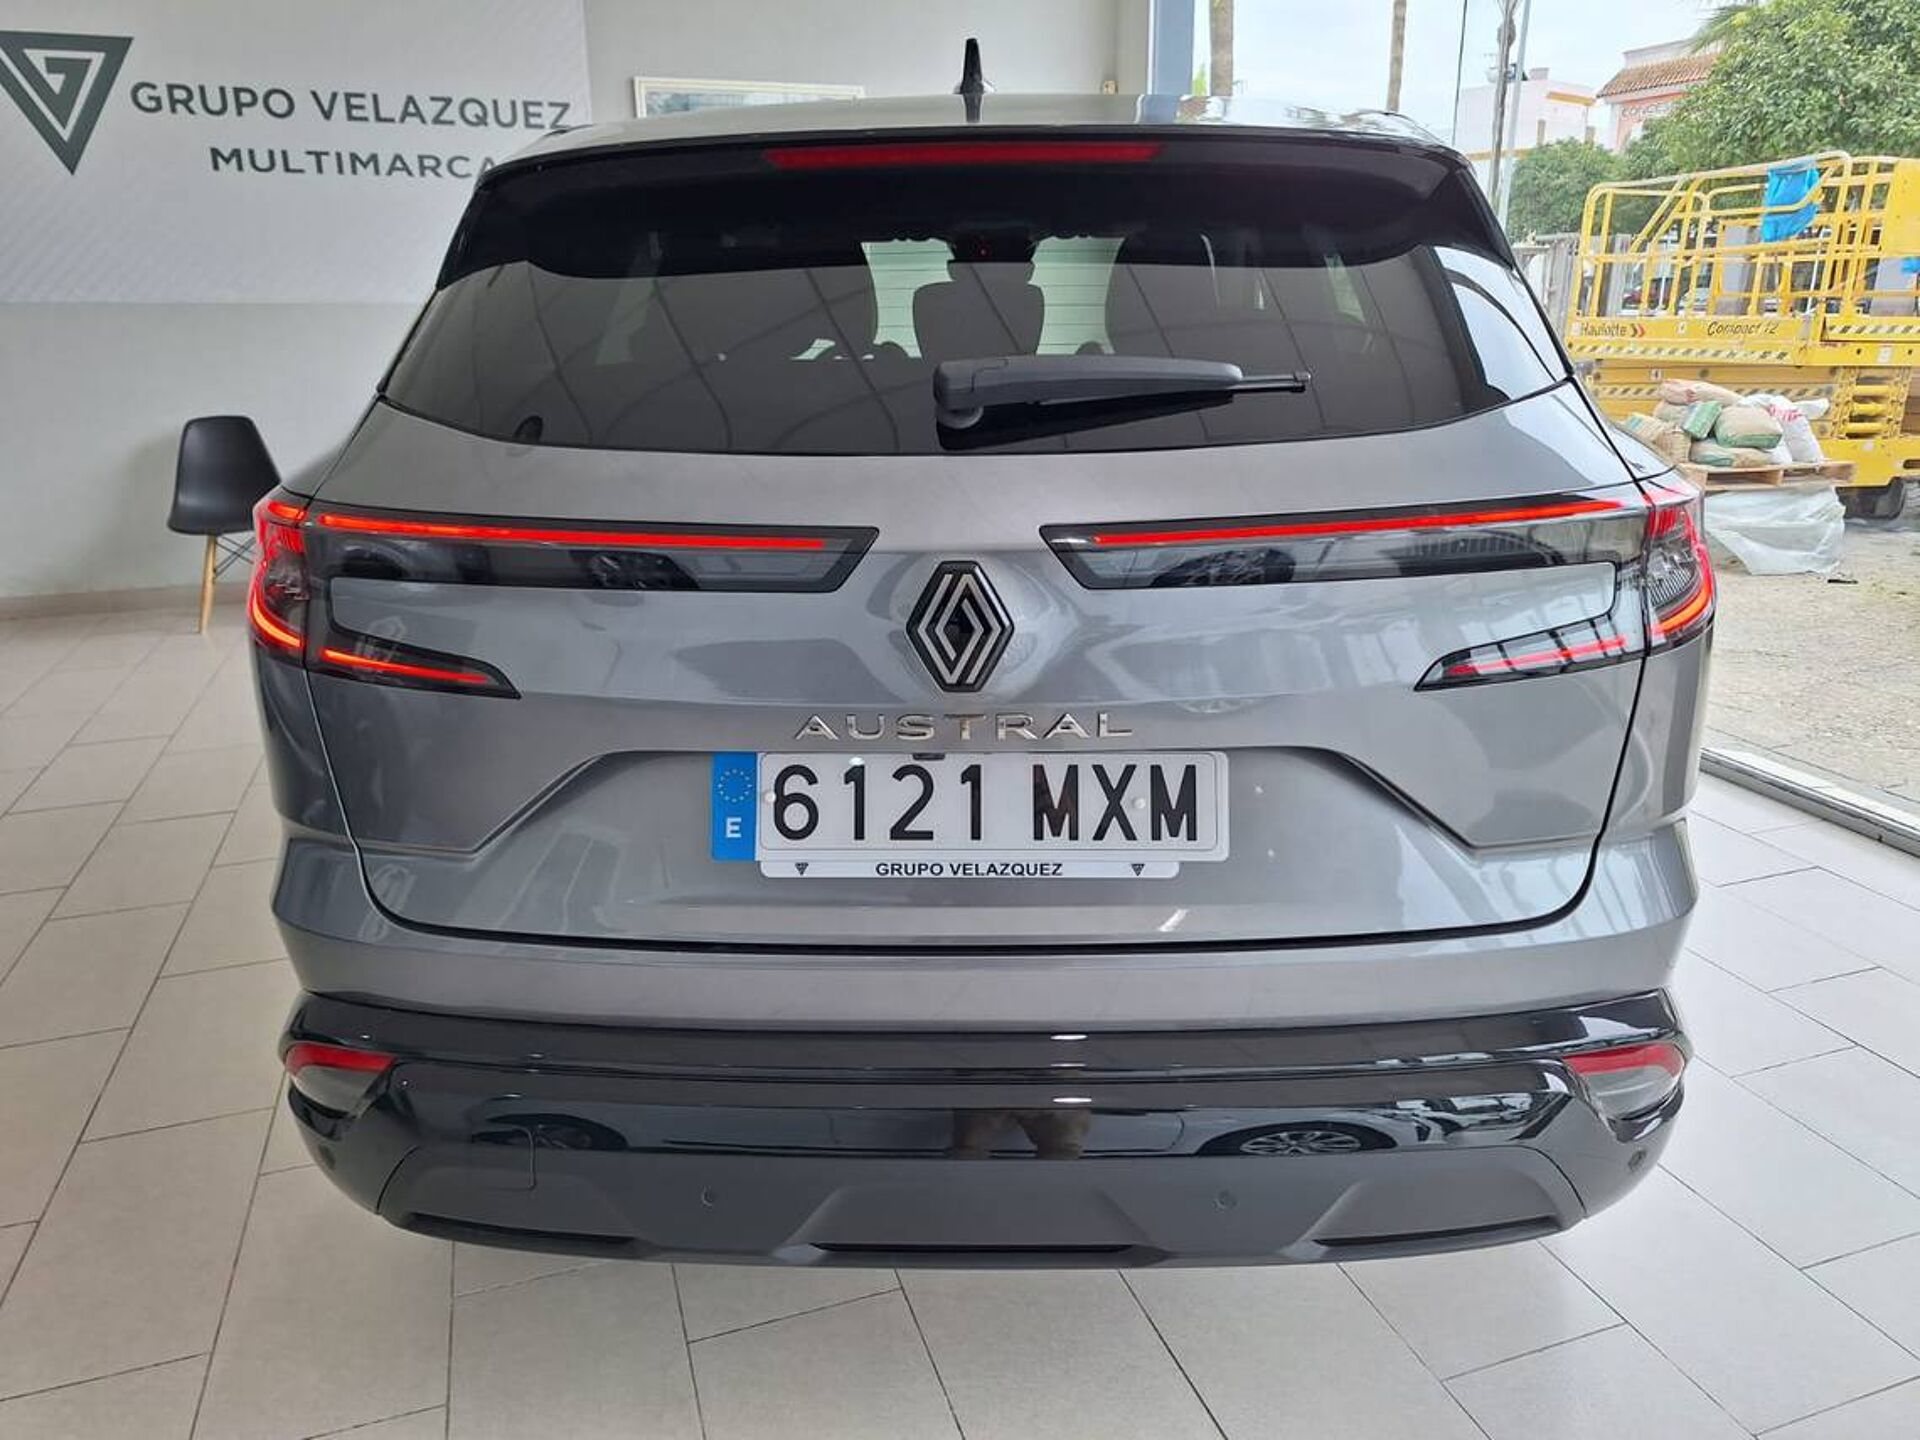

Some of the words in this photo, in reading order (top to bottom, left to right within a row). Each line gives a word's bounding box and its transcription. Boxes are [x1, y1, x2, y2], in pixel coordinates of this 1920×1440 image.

[130, 81, 296, 119] GRUPO
[310, 90, 570, 129] VELAZQUEZ
[795, 713, 1134, 741] AUSTRAL
[772, 763, 983, 842] 6121
[1032, 763, 1198, 842] MXM
[726, 817, 742, 838] E
[875, 862, 944, 877] GRUPO
[949, 862, 1063, 877] VELAZQUEZ
